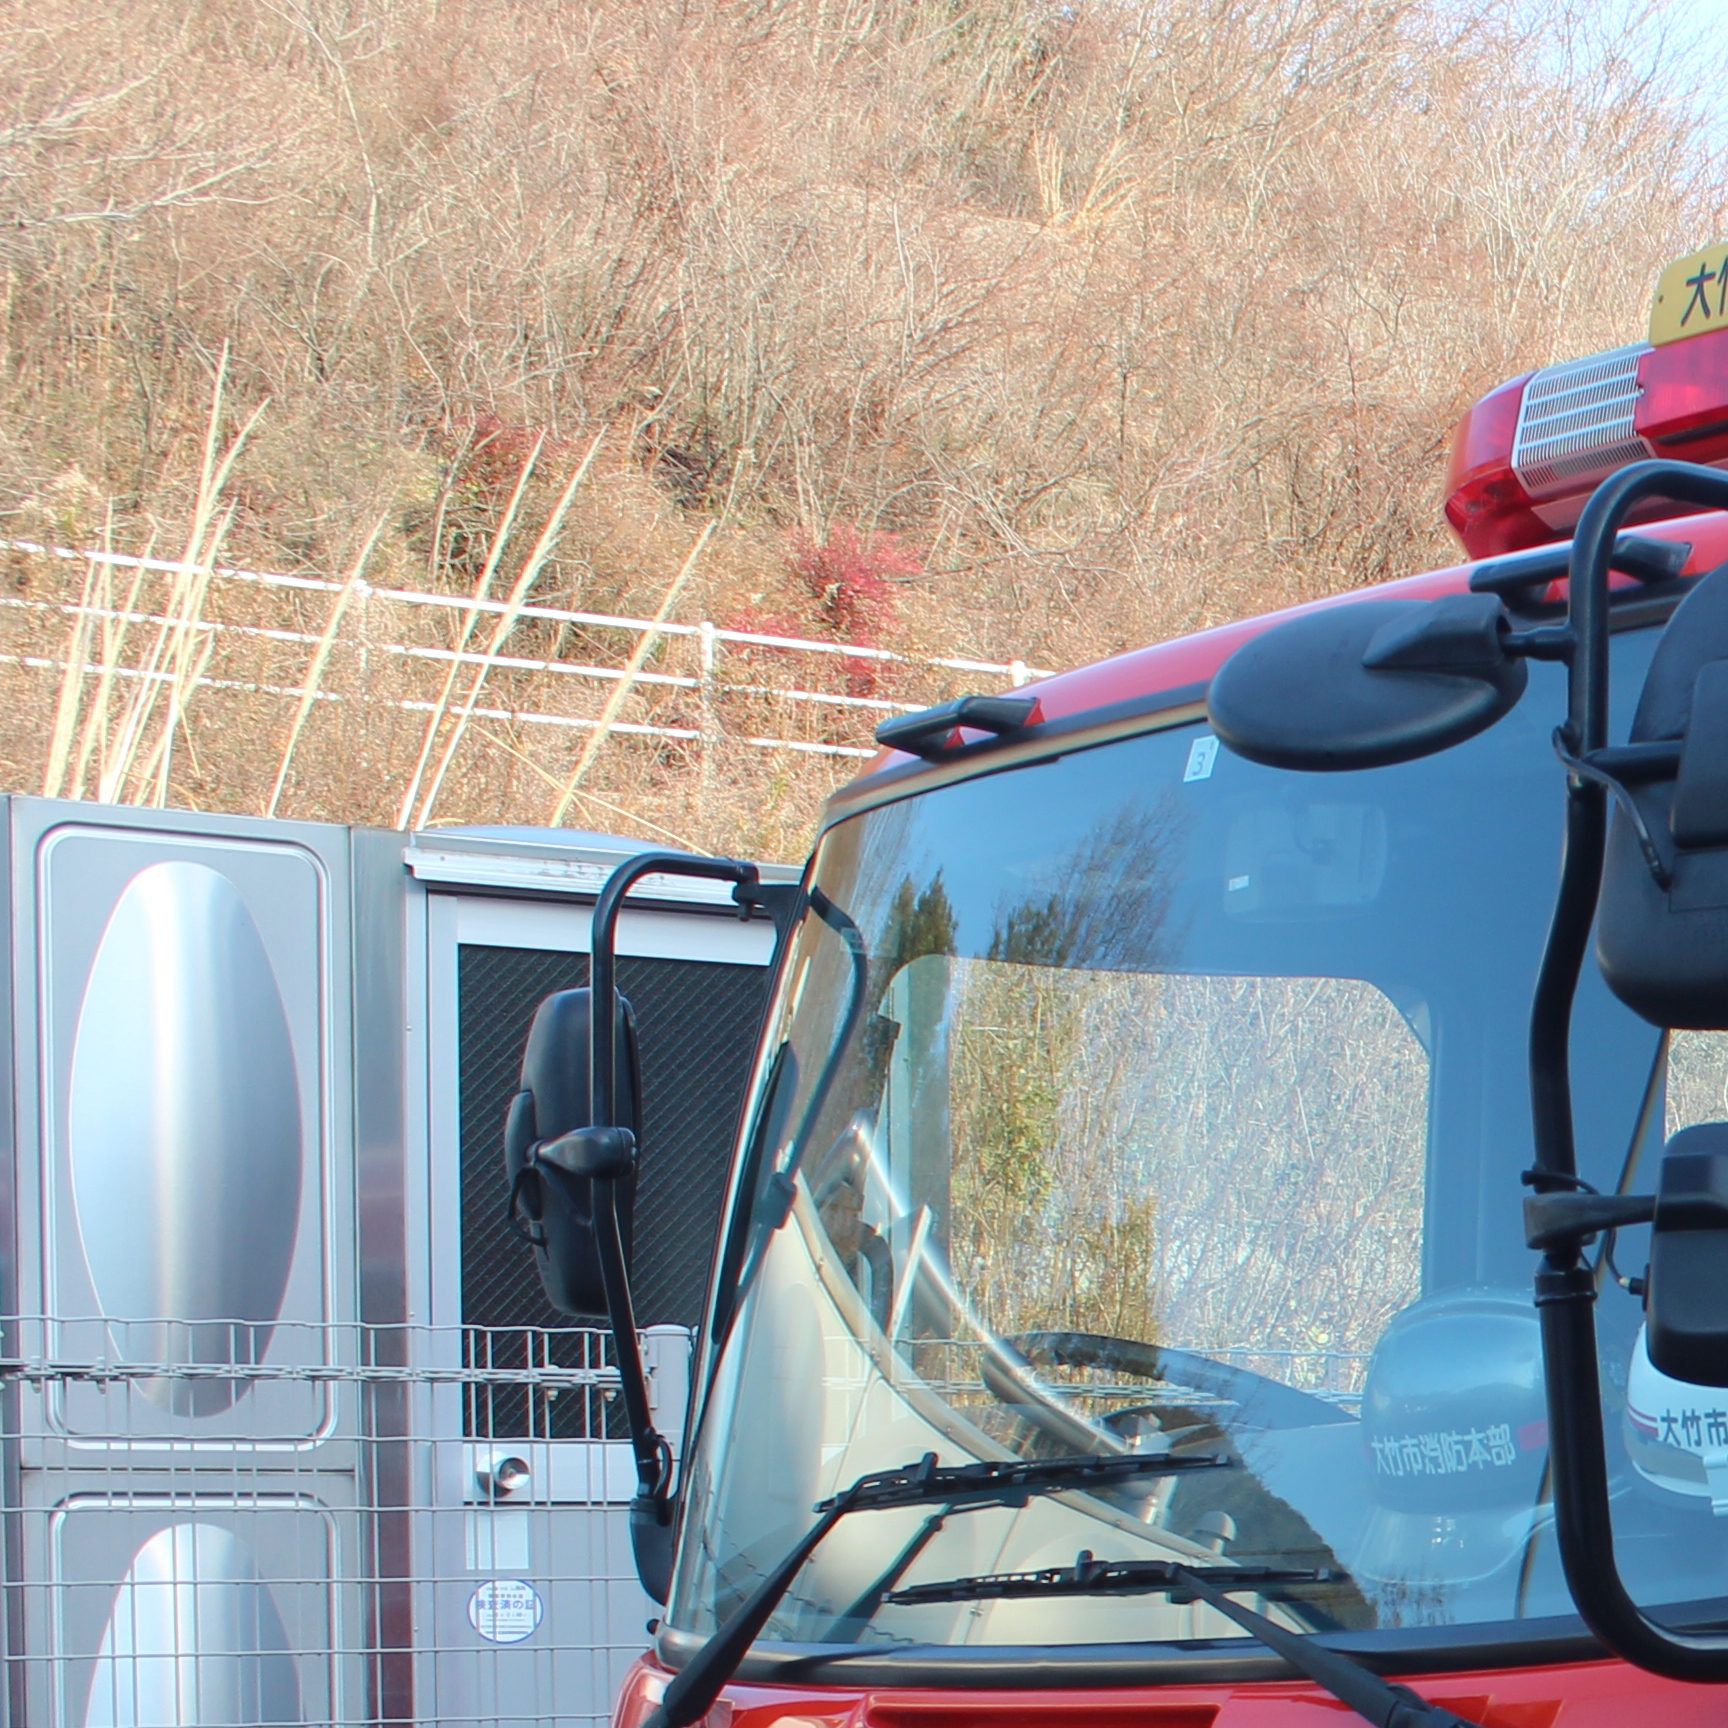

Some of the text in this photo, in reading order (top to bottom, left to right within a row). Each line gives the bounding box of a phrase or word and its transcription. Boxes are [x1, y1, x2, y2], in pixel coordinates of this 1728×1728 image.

[1371, 1423, 1516, 1477] 大竹市消防本部
